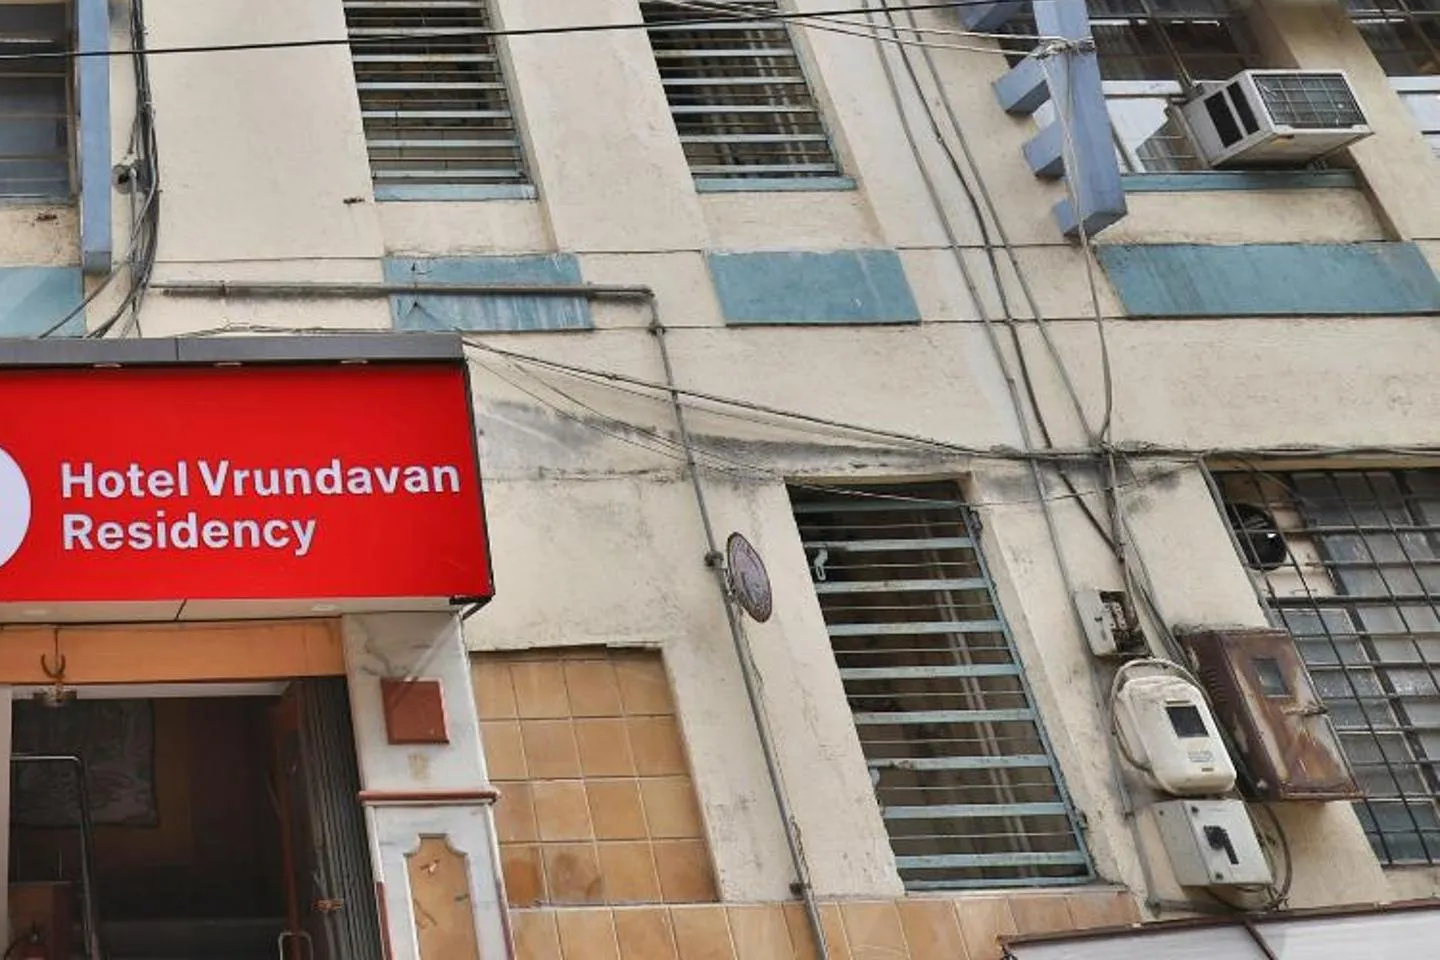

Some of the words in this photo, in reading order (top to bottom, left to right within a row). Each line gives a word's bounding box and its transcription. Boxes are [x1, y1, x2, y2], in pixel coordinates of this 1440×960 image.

[61, 460, 188, 499] Hotel
[197, 458, 461, 497] Vrundavan
[63, 510, 317, 556] Residency
